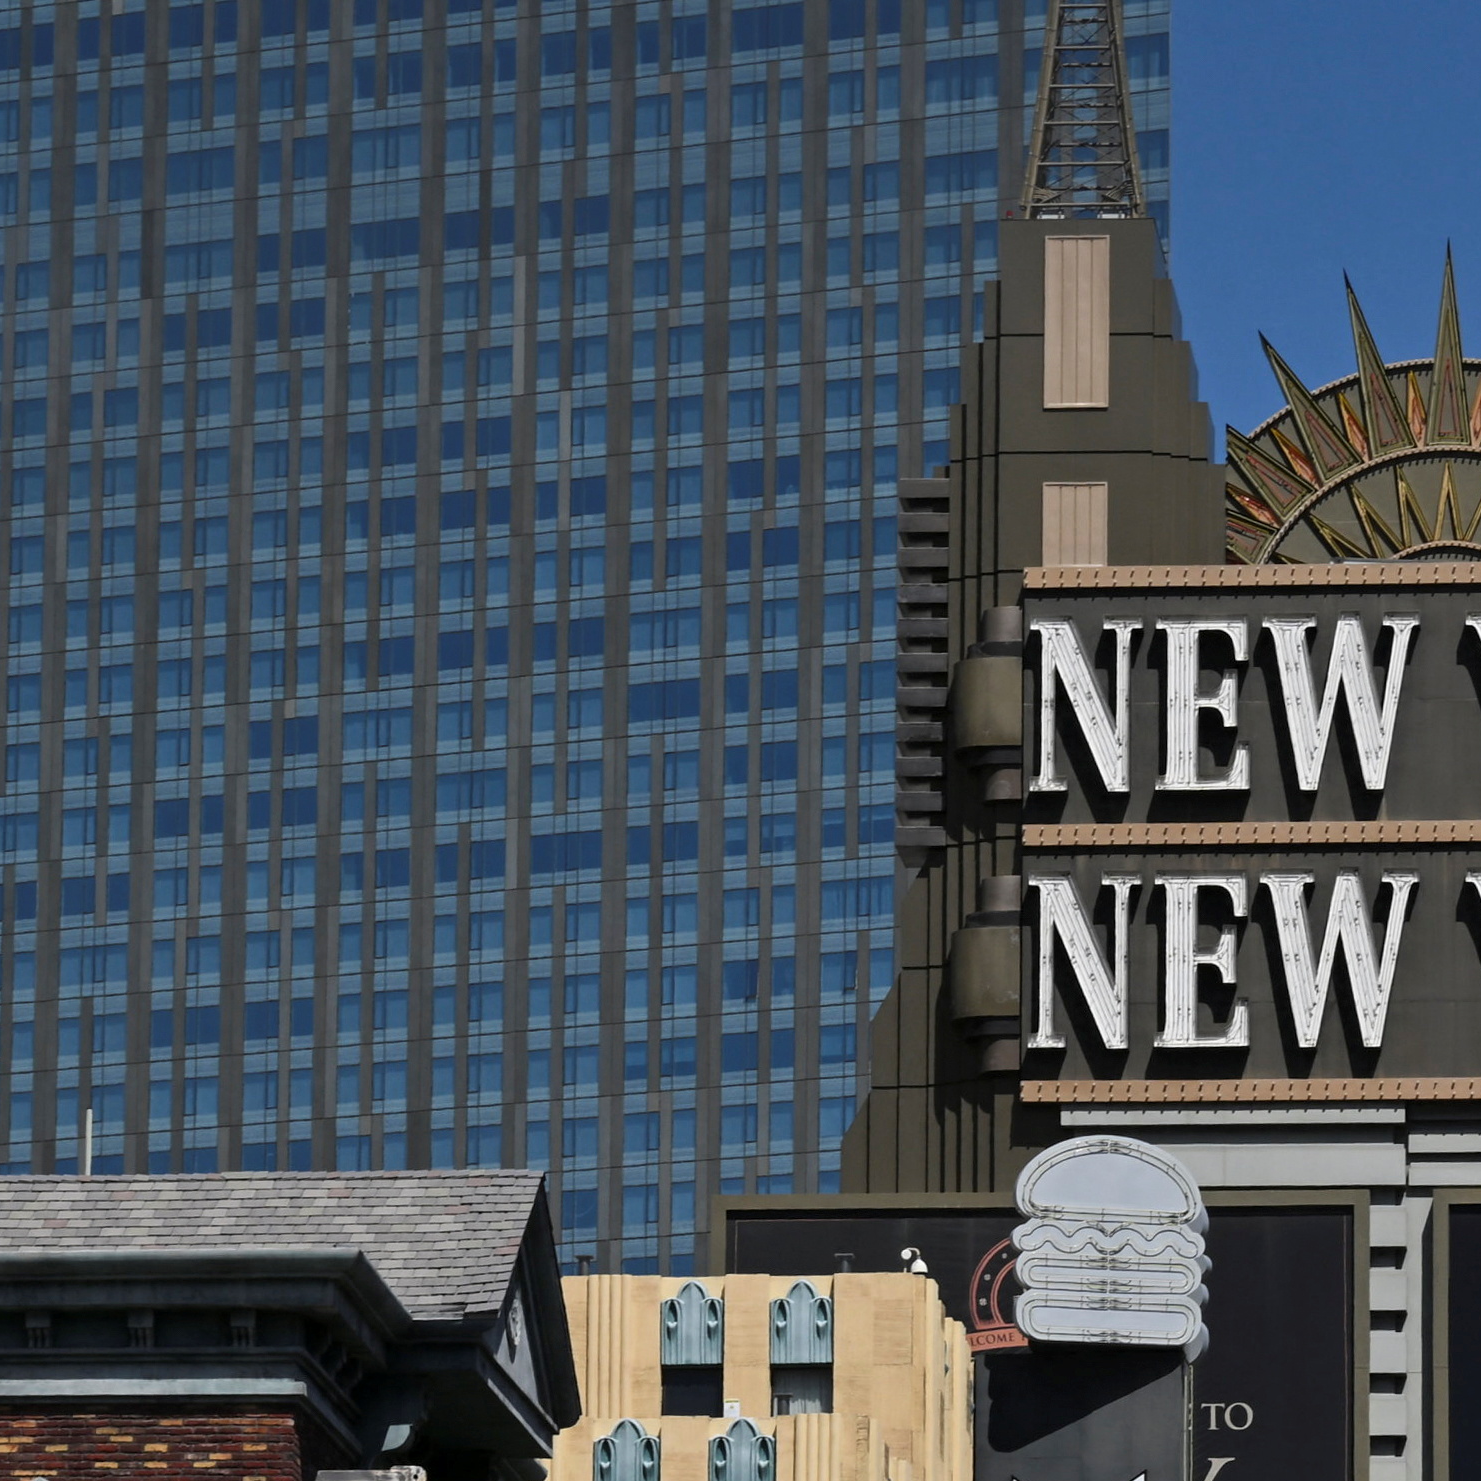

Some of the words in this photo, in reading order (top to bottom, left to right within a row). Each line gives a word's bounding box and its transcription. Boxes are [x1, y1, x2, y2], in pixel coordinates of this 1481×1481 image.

[1028, 611, 1421, 793] NEW
[1026, 867, 1420, 1050] NEW
[1200, 1401, 1254, 1431] TO
